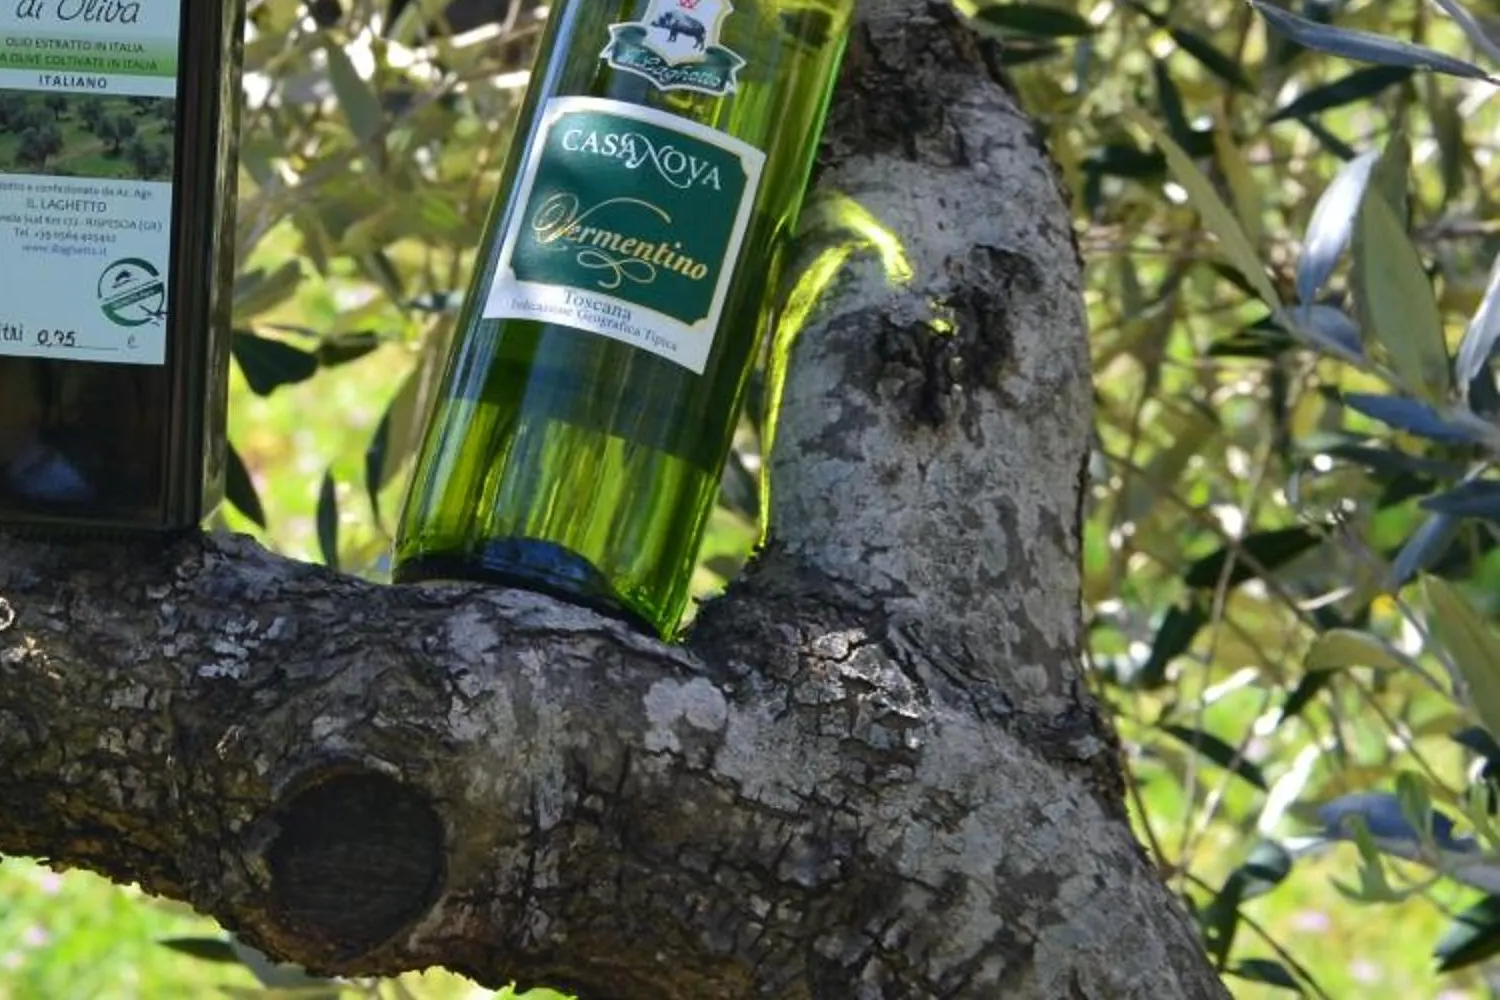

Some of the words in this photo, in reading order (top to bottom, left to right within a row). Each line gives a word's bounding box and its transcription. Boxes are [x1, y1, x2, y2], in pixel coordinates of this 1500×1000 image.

[5, 37, 32, 47] OLIO
[35, 38, 91, 50] ESTRATTO
[95, 41, 107, 51] IN
[108, 41, 144, 53] ITALIA
[123, 59, 157, 71] ITALIA
[39, 74, 108, 89] ITALIANO
[26, 198, 37, 209] IL
[41, 199, 107, 214] LAGHETTO
[531, 192, 708, 281] Vermentino
[564, 288, 633, 320] Toscana
